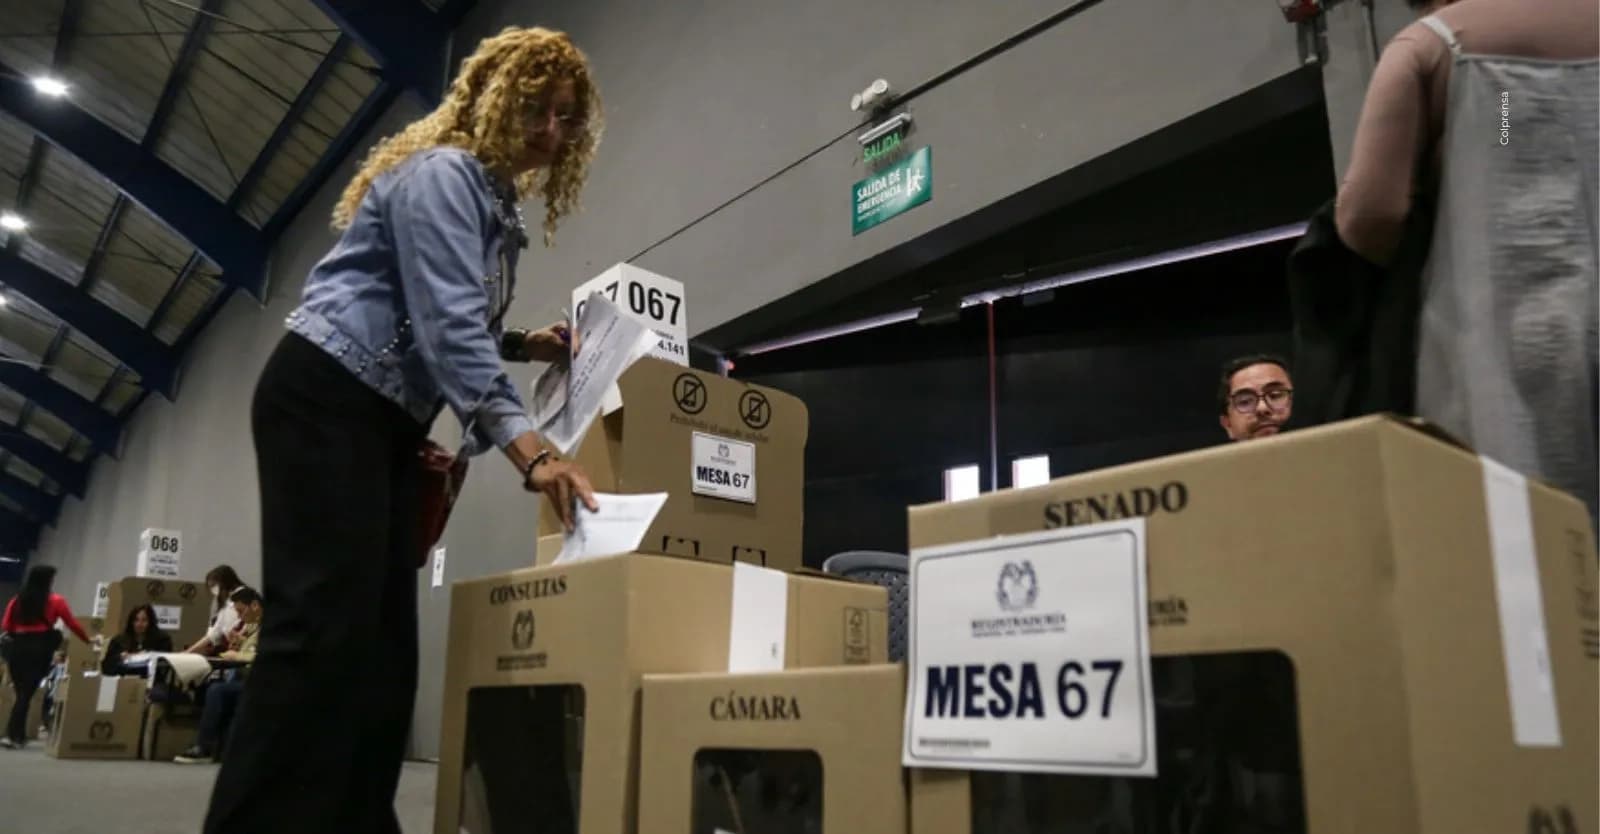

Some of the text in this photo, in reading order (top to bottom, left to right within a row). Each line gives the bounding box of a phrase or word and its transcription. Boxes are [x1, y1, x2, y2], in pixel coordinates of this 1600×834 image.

[863, 132, 901, 162] SALIDA
[857, 169, 901, 201] SALIDA DE
[857, 184, 903, 214] EMERGENCIA
[629, 281, 681, 326] 067
[696, 466, 750, 489] MESA 67
[1043, 481, 1189, 531] SENADO
[151, 535, 179, 553] 068
[490, 575, 568, 605] CONSULTAS
[710, 690, 802, 722] CÁMARA
[924, 660, 1126, 721] MESA 67
